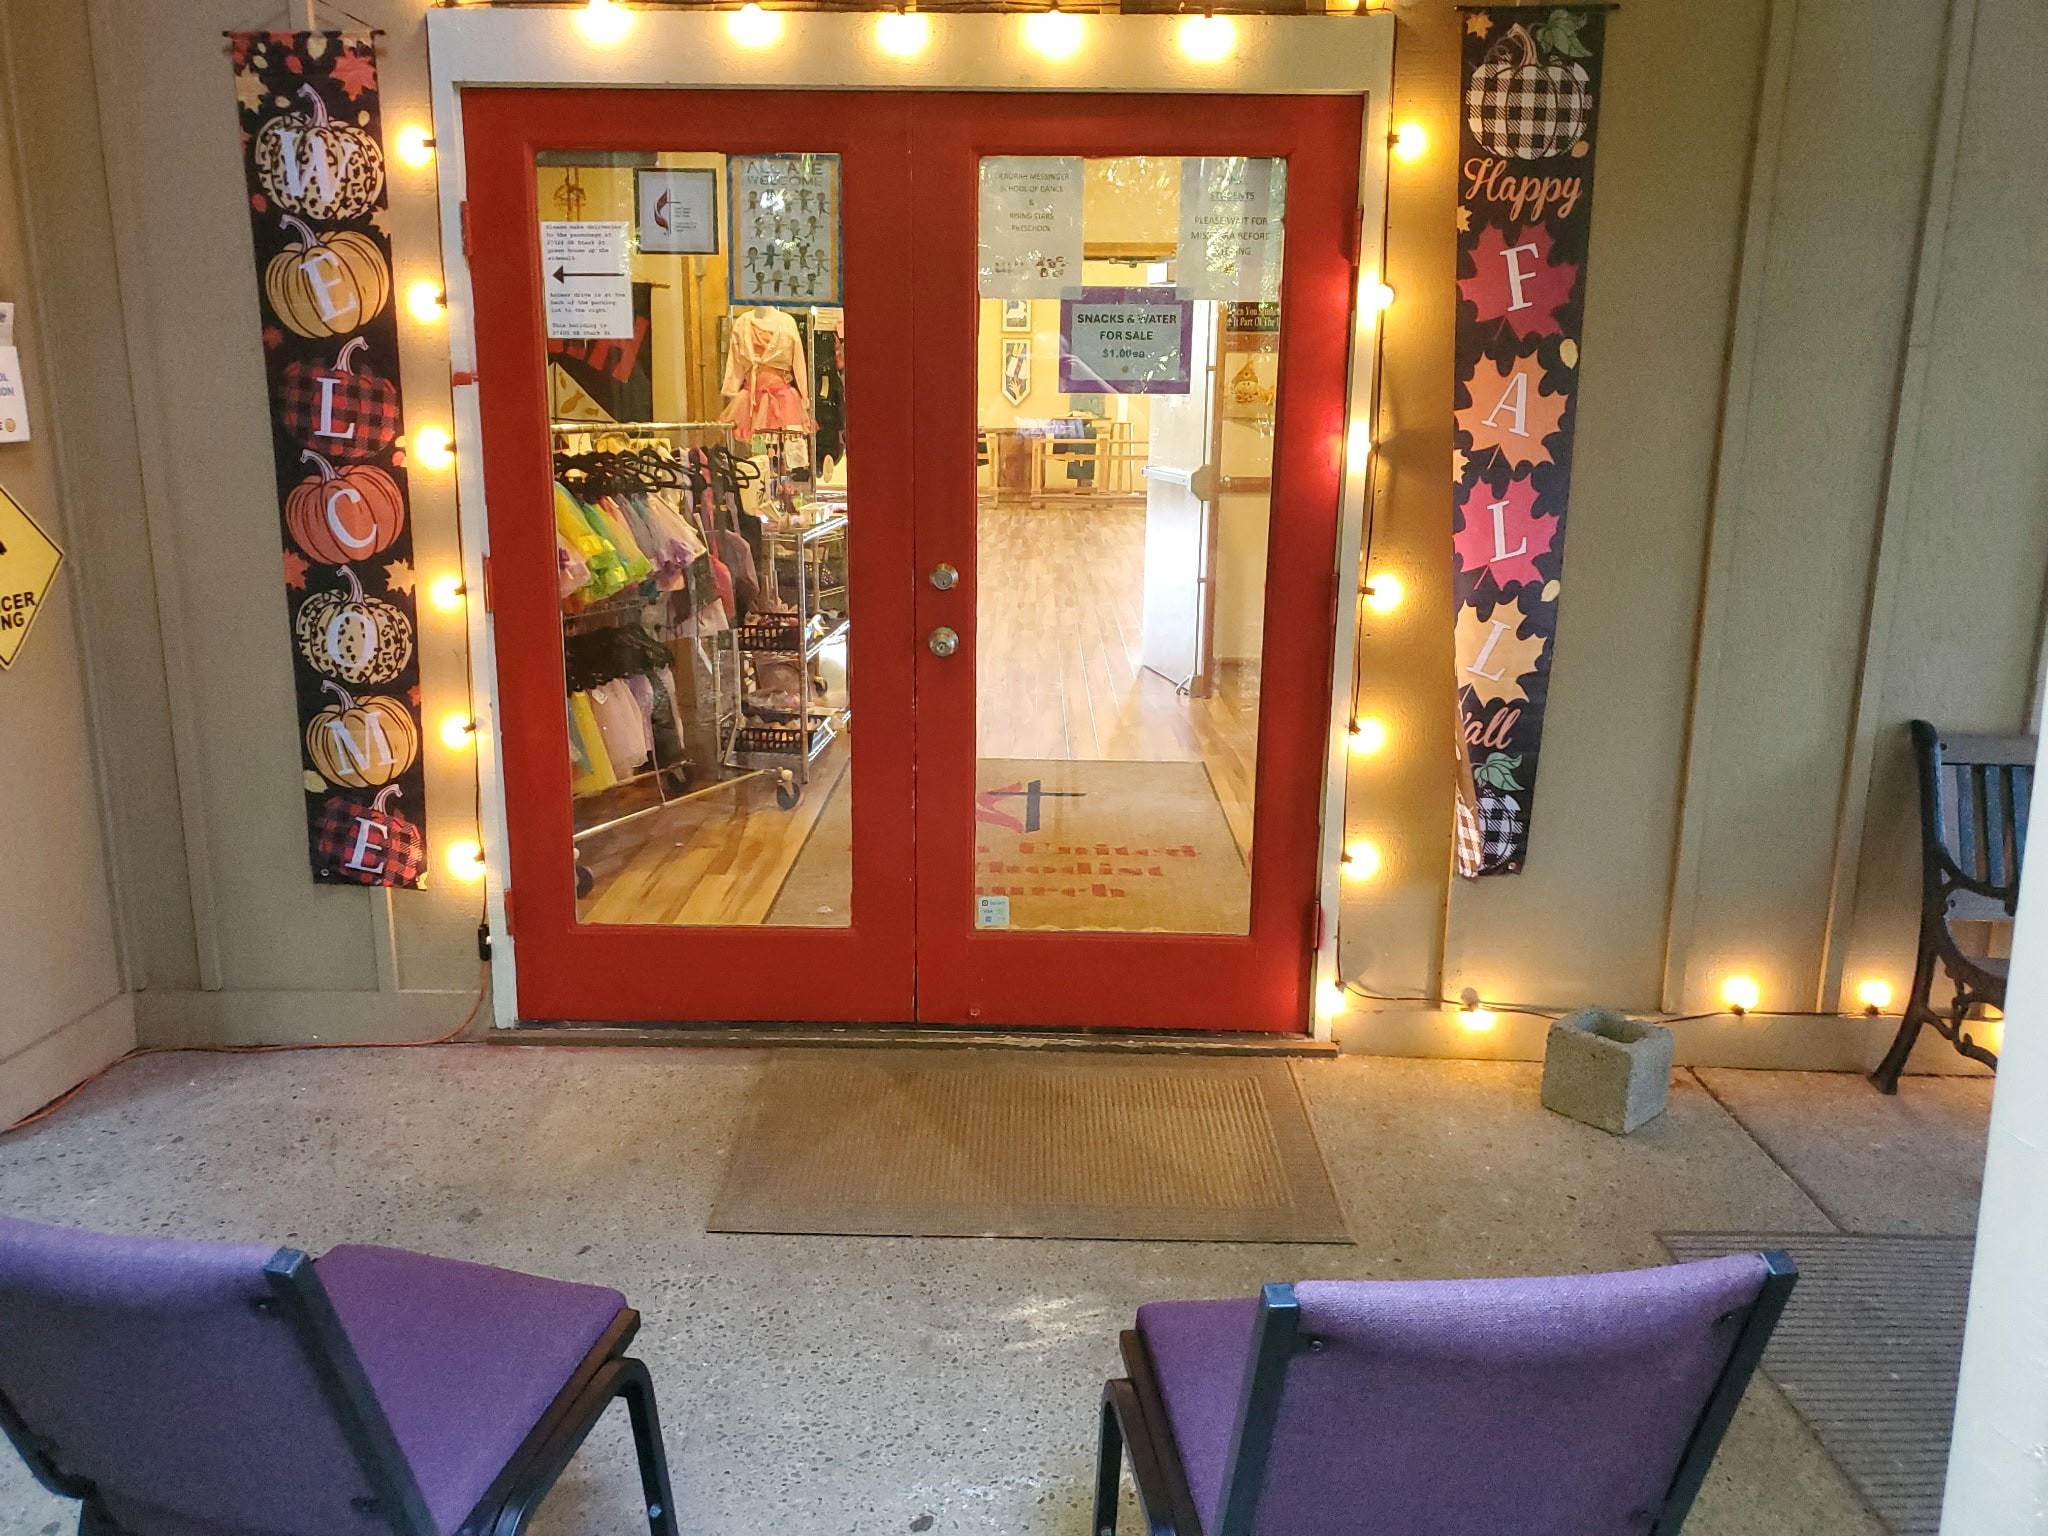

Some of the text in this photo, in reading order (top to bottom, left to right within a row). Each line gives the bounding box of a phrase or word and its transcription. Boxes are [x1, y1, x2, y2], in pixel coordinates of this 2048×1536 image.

[746, 161, 823, 176] ALL AE
[747, 175, 823, 186] WELCOME
[998, 172, 1070, 181] EBORAH MESSINGER
[1000, 185, 1064, 193] SCHOOL OF DANCE
[1463, 157, 1582, 220] Happy
[1033, 212, 1054, 220] STARS
[1194, 216, 1268, 225] PLEASE WAIT FOR
[1011, 224, 1051, 232] PRESCHOOL
[1237, 231, 1271, 240] BEFORE
[1245, 305, 1258, 316] You
[1077, 313, 1177, 324] SNACKS & WATER
[1240, 316, 1253, 327] Part
[1100, 331, 1153, 340] FOR SALE
[0, 591, 36, 612] CER
